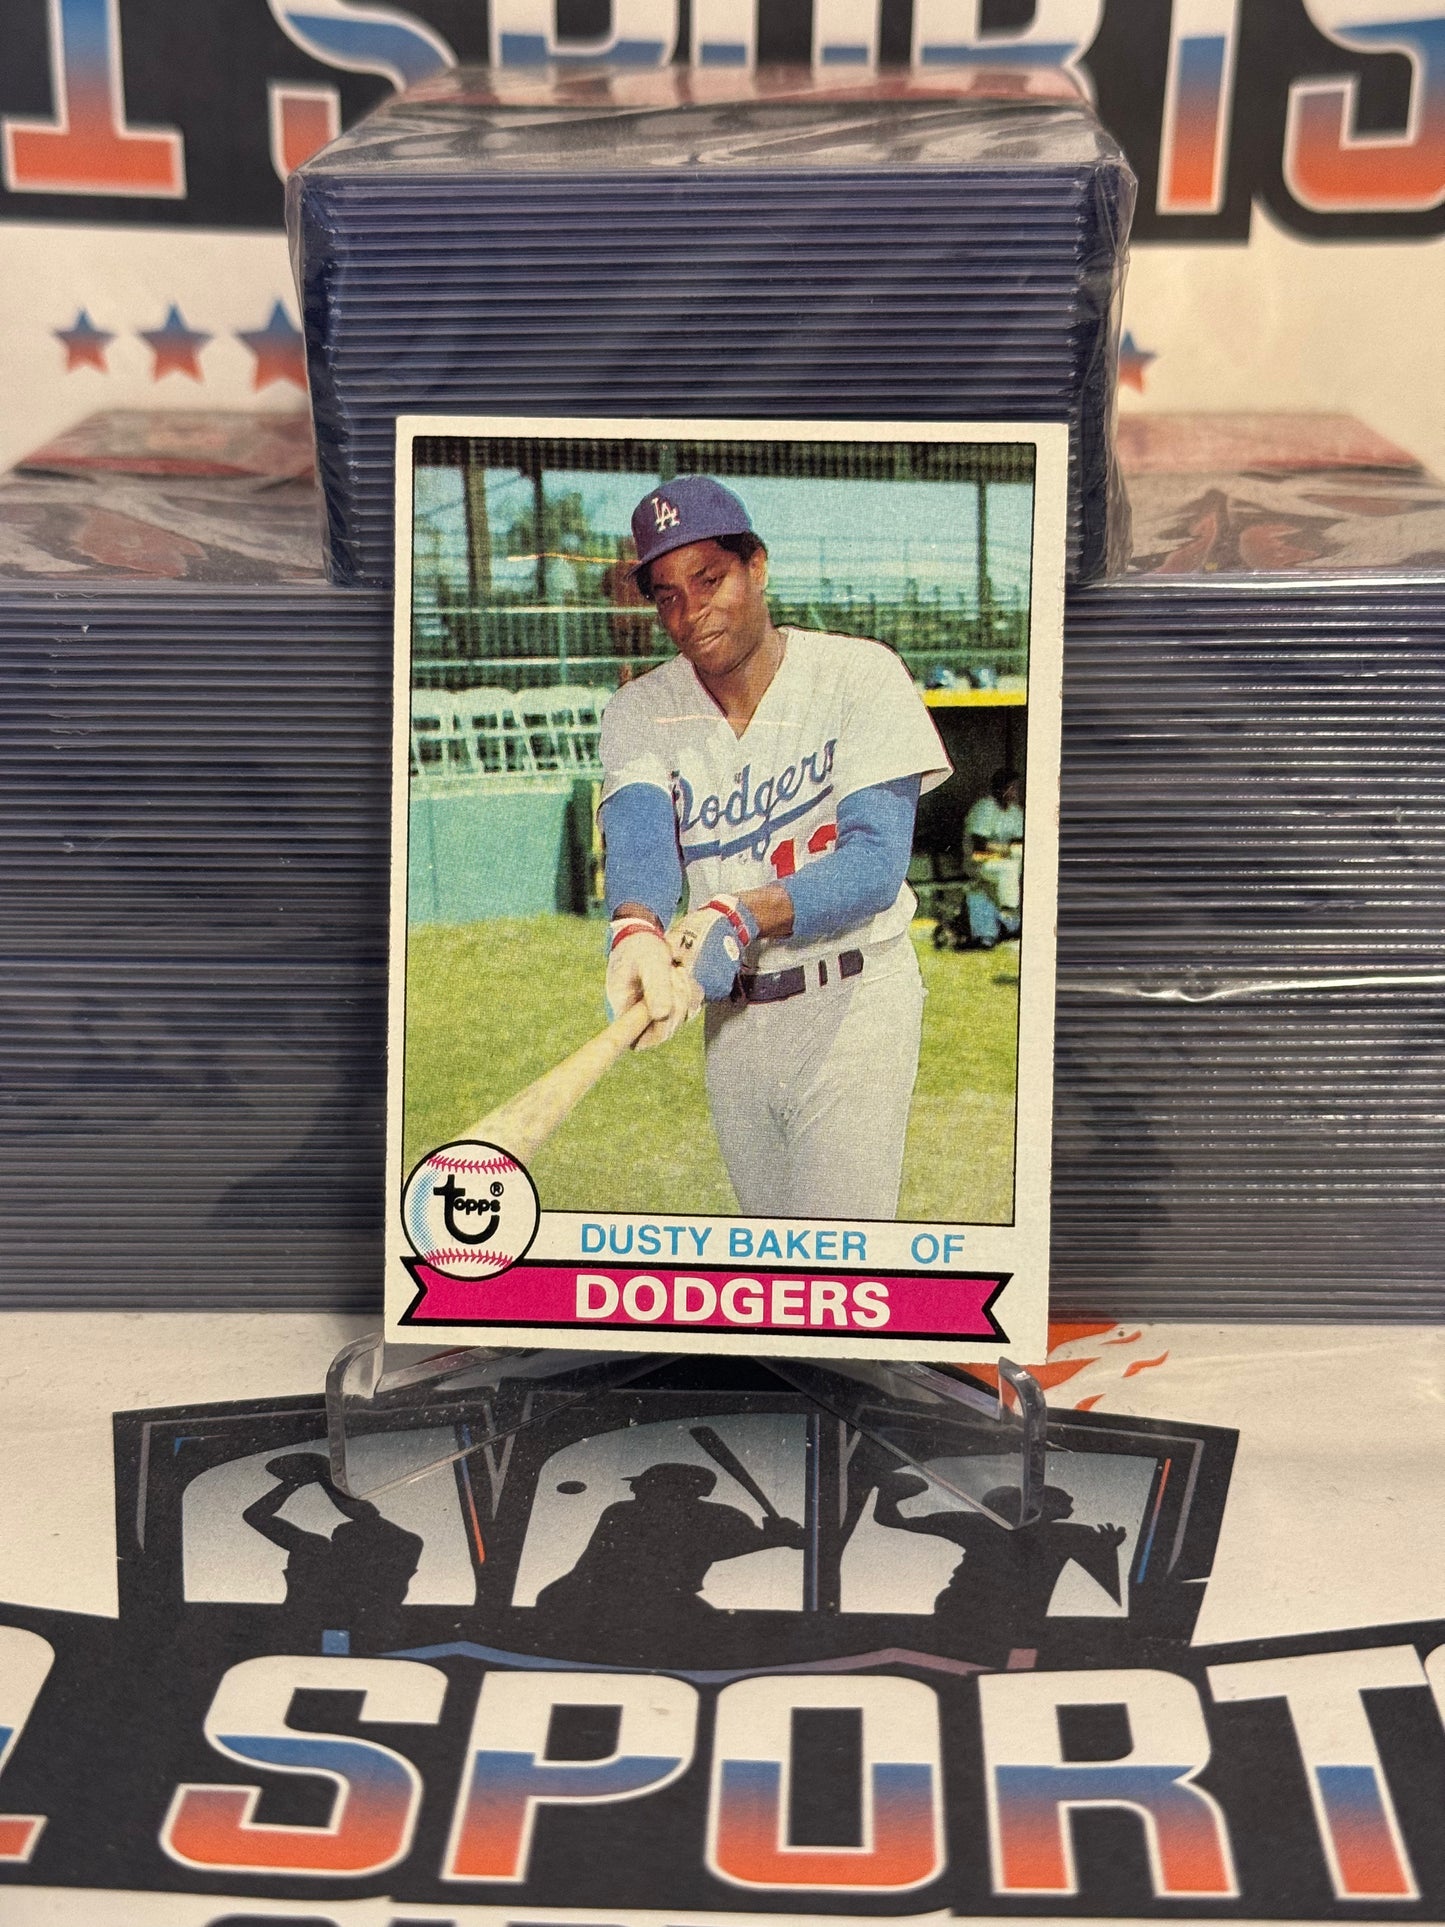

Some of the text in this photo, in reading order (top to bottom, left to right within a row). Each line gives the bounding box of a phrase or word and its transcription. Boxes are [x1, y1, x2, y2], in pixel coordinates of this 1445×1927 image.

[651, 497, 680, 532] LA
[433, 1174, 500, 1245] topps
[580, 1222, 966, 1264] DUSTY BAKER OF
[575, 1274, 891, 1328] DODGERS
[159, 1642, 1445, 1902] SPORT
